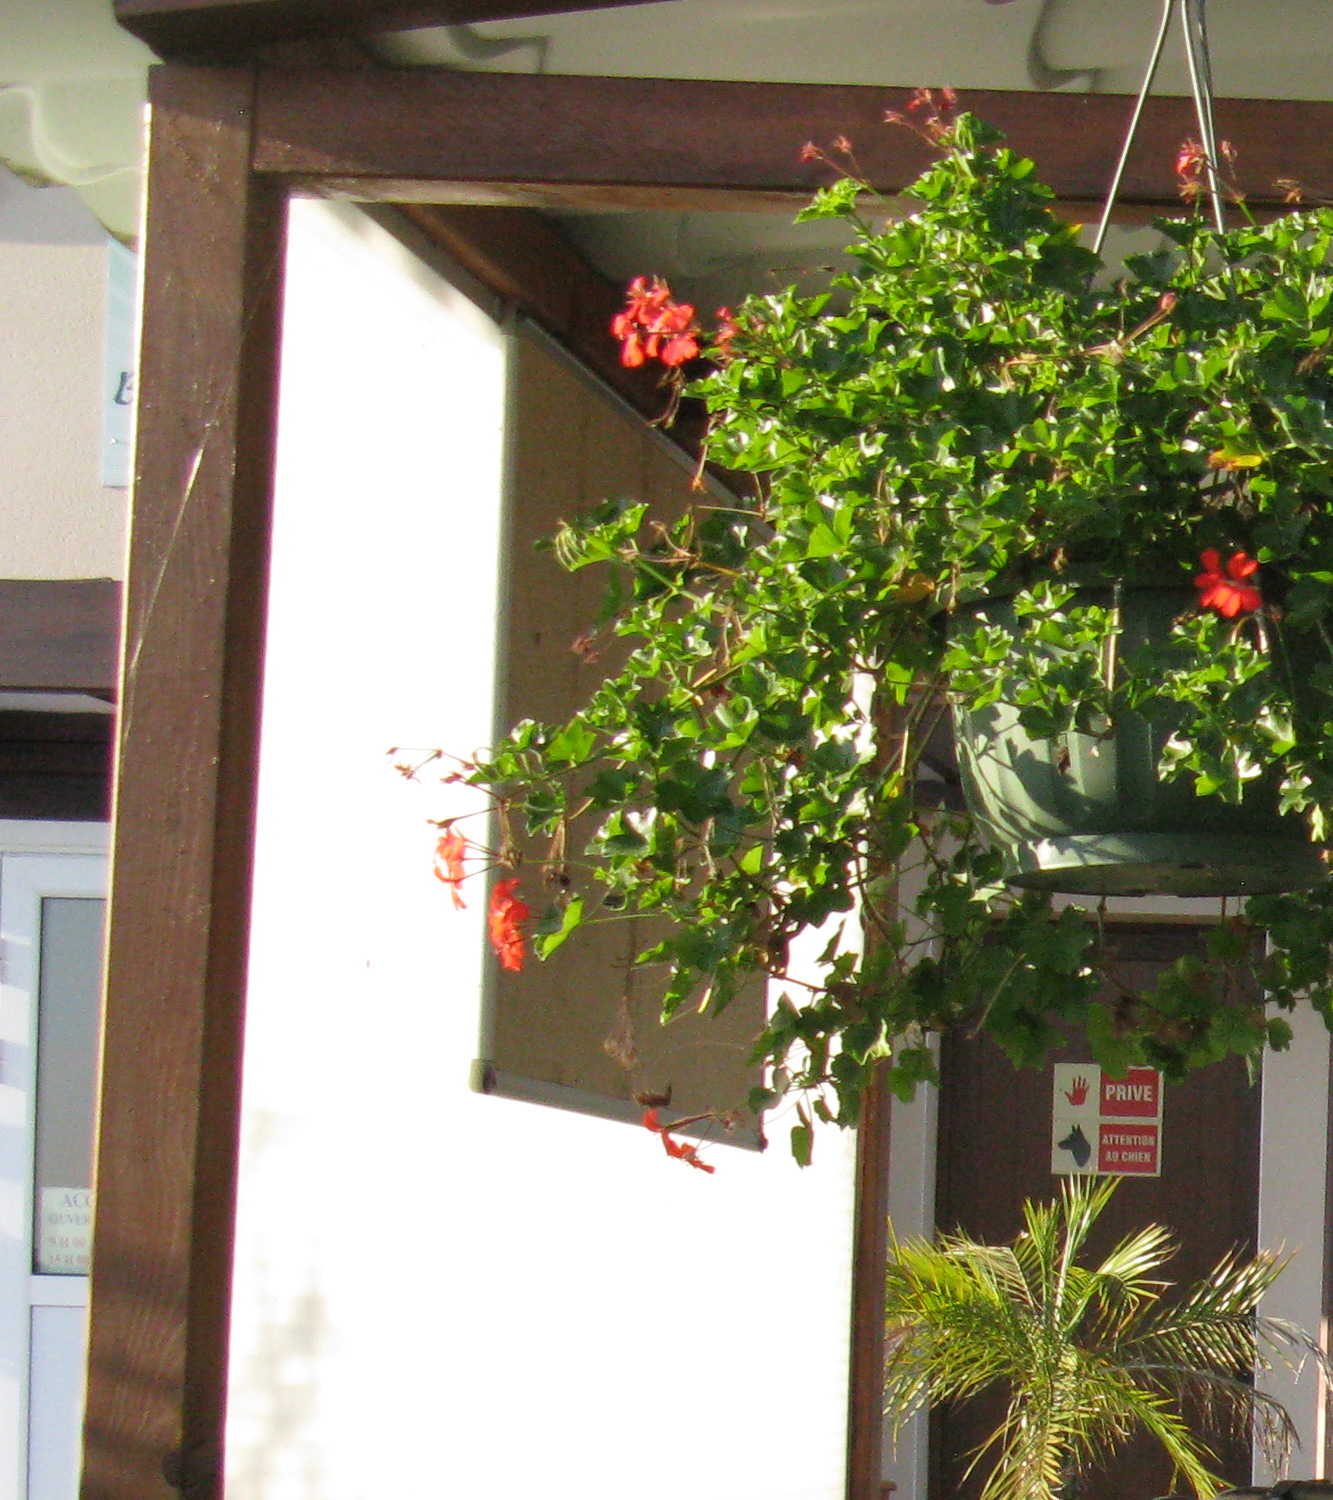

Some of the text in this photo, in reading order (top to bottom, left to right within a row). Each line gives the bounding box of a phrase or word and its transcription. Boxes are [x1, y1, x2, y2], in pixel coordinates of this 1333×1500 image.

[1105, 1084, 1153, 1102] PRIVE
[1102, 1134, 1156, 1146] ATTENTION
[1105, 1150, 1151, 1163] AU CHIEN
